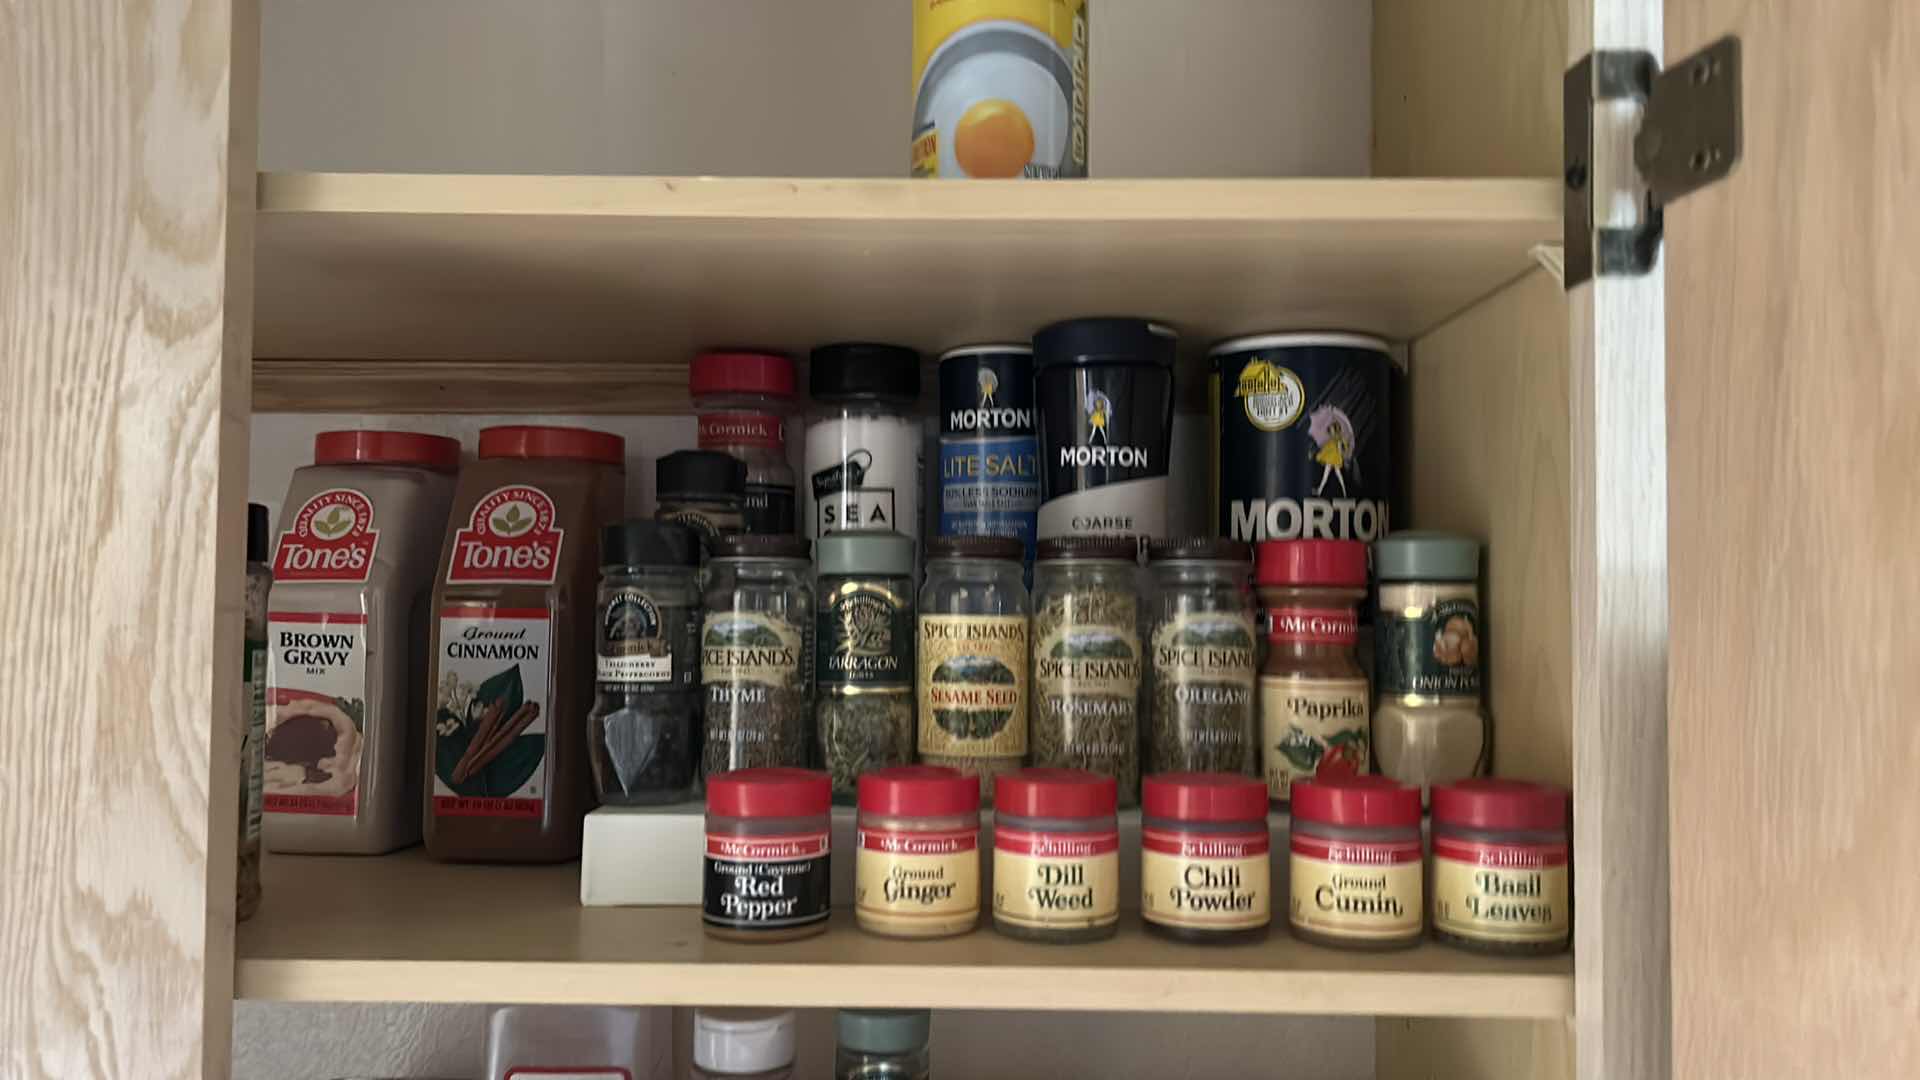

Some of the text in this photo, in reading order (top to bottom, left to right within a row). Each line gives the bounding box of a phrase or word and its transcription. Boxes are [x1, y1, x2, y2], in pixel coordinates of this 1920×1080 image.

[950, 408, 1031, 431] MORTON
[943, 454, 978, 478] LITE
[1060, 446, 1149, 468] MORTON
[299, 495, 332, 538] QUALITY
[476, 491, 512, 535] QUALITY
[824, 503, 887, 524] SEA
[1230, 498, 1389, 542] MORTON
[282, 543, 368, 570] Tone's
[460, 541, 551, 570] Tone's
[280, 631, 355, 650] BROWN
[463, 626, 527, 641] Ground
[924, 621, 1024, 642] SPICE ISLANDS
[284, 649, 350, 667] GRAVY
[447, 642, 540, 660] CINNAMON
[727, 648, 794, 667] ISLANDS
[306, 667, 326, 676] MIX
[828, 654, 899, 671] TARRAGON
[1040, 657, 1079, 680] SPICE
[711, 687, 767, 703] THYME
[931, 687, 1018, 706] SESAME SEED
[1287, 697, 1364, 720] Paprika
[720, 841, 800, 857] McCormick
[880, 838, 958, 854] McCormick
[714, 861, 753, 875] Ground
[892, 865, 944, 880] Ground
[1037, 864, 1084, 886] Dill
[1184, 864, 1241, 890] Chili
[734, 876, 784, 898] Red
[884, 878, 957, 905] Ginger
[1332, 874, 1386, 890] Ground
[1475, 872, 1541, 897] Basil
[720, 893, 799, 921] Pepper
[1028, 888, 1094, 910] Weed
[1170, 887, 1256, 911] Powder
[1315, 884, 1404, 918] Cumin
[1465, 895, 1552, 923] Leaves
